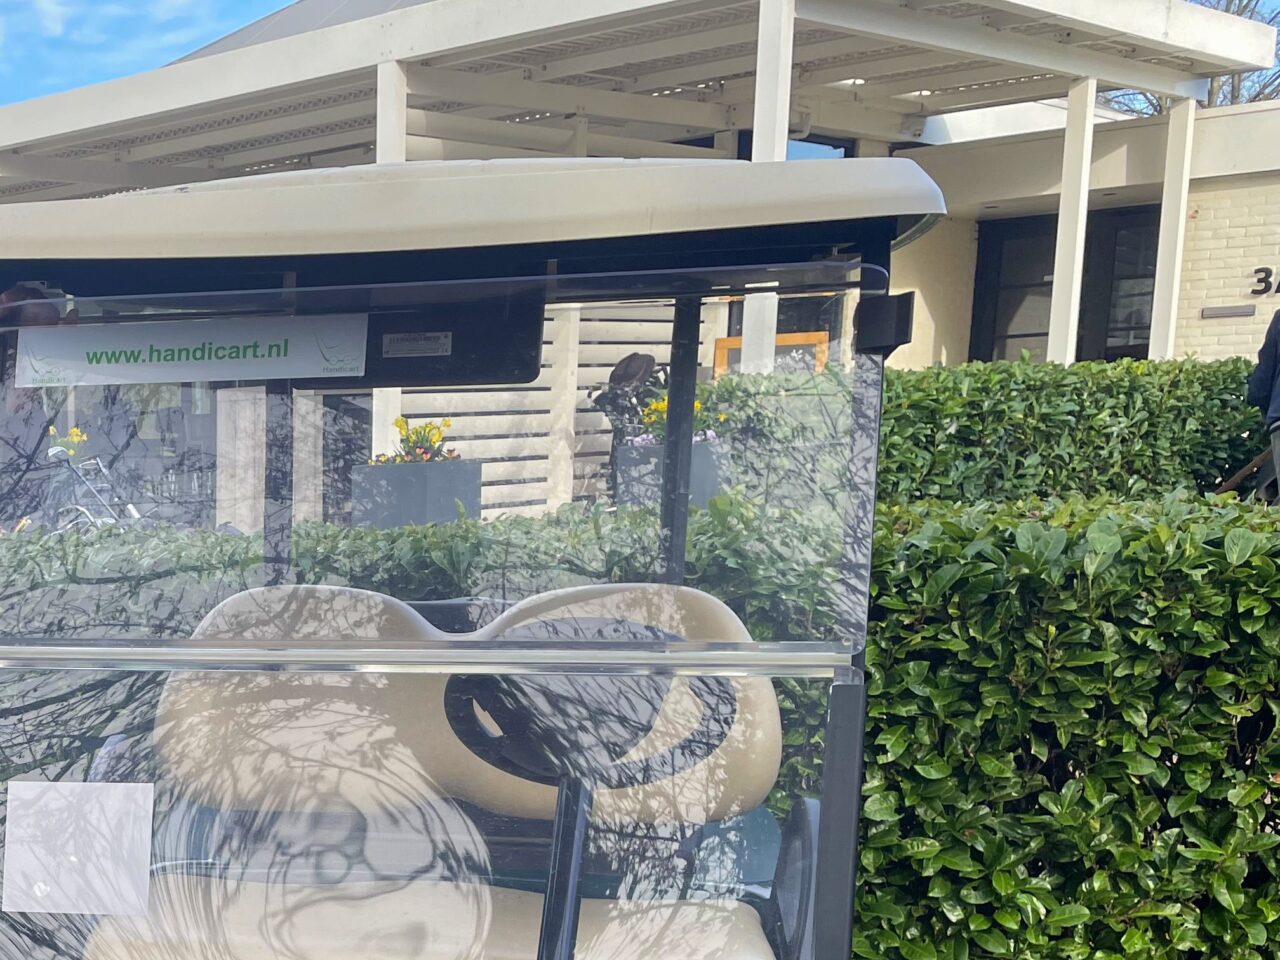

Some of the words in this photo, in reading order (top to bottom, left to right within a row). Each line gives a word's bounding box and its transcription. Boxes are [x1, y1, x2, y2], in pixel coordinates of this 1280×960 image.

[1251, 266, 1280, 296] 3
[85, 338, 289, 366] www.handicart.nl
[322, 366, 360, 374] Handicart
